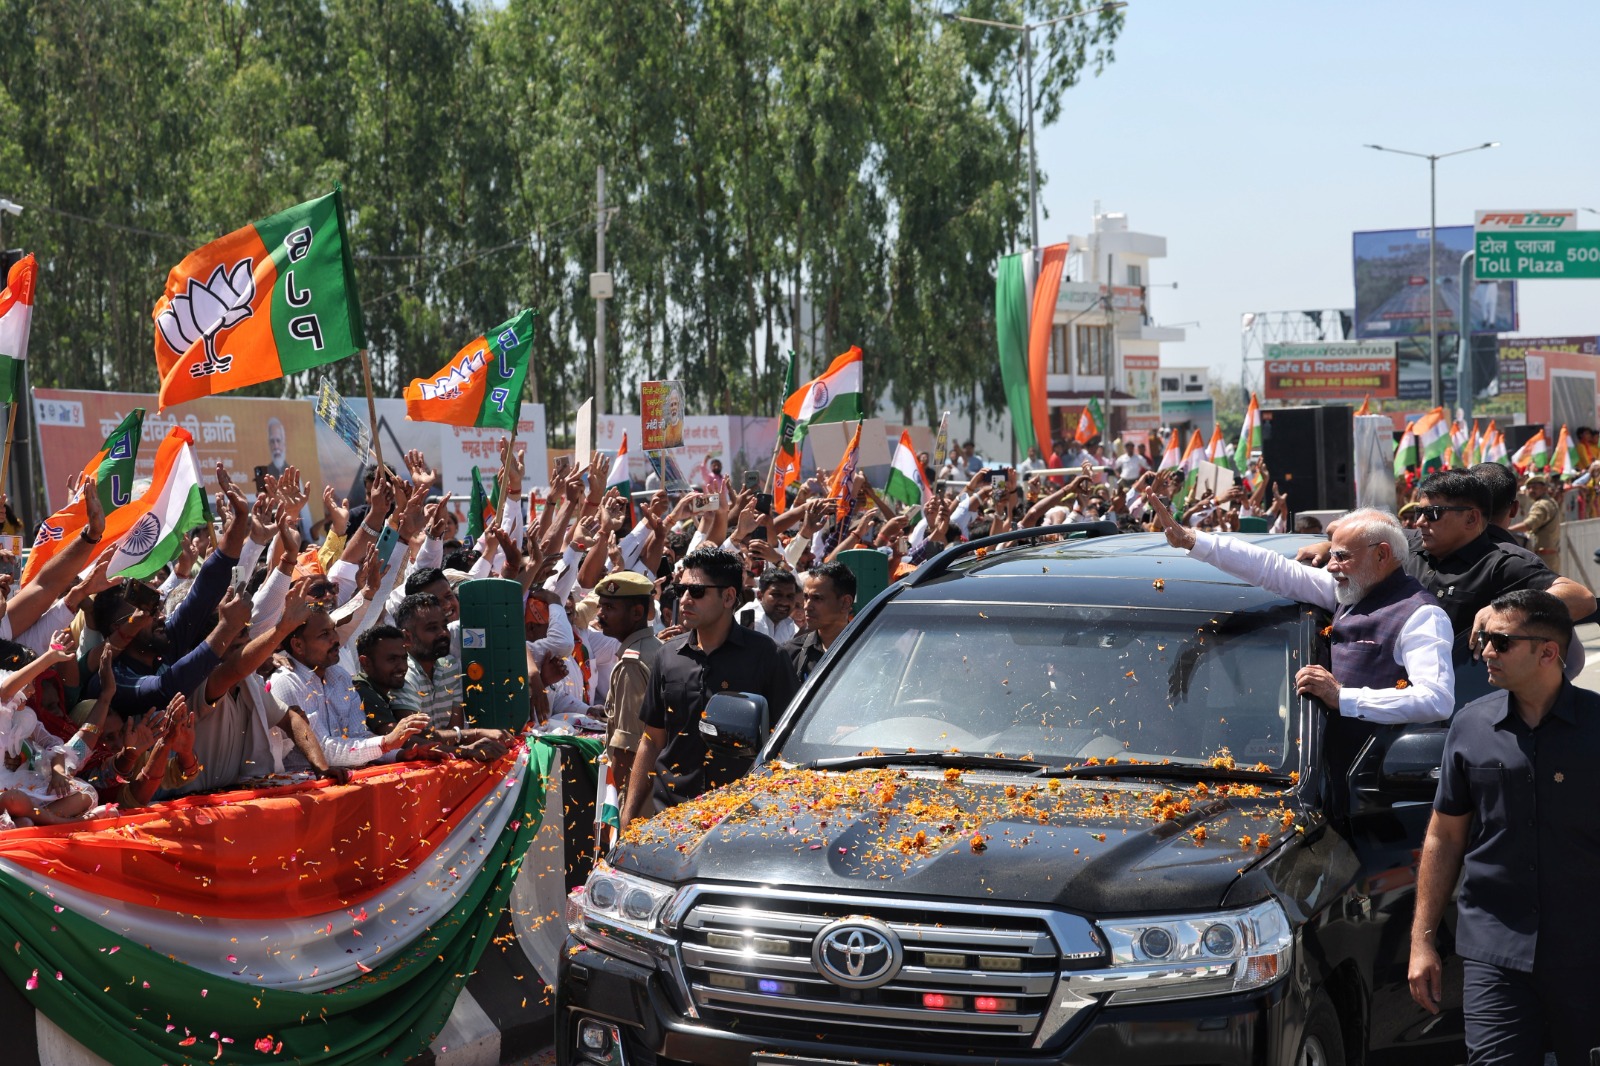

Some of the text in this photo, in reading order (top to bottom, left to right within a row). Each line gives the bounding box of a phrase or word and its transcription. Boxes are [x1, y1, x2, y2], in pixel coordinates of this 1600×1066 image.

[1479, 235, 1507, 253] टोल
[1479, 257, 1564, 273] Toll Plaza
[1268, 360, 1392, 373] Cafe & Restaurant
[1343, 376, 1381, 387] ROOMS
[201, 414, 236, 443] क्रांति
